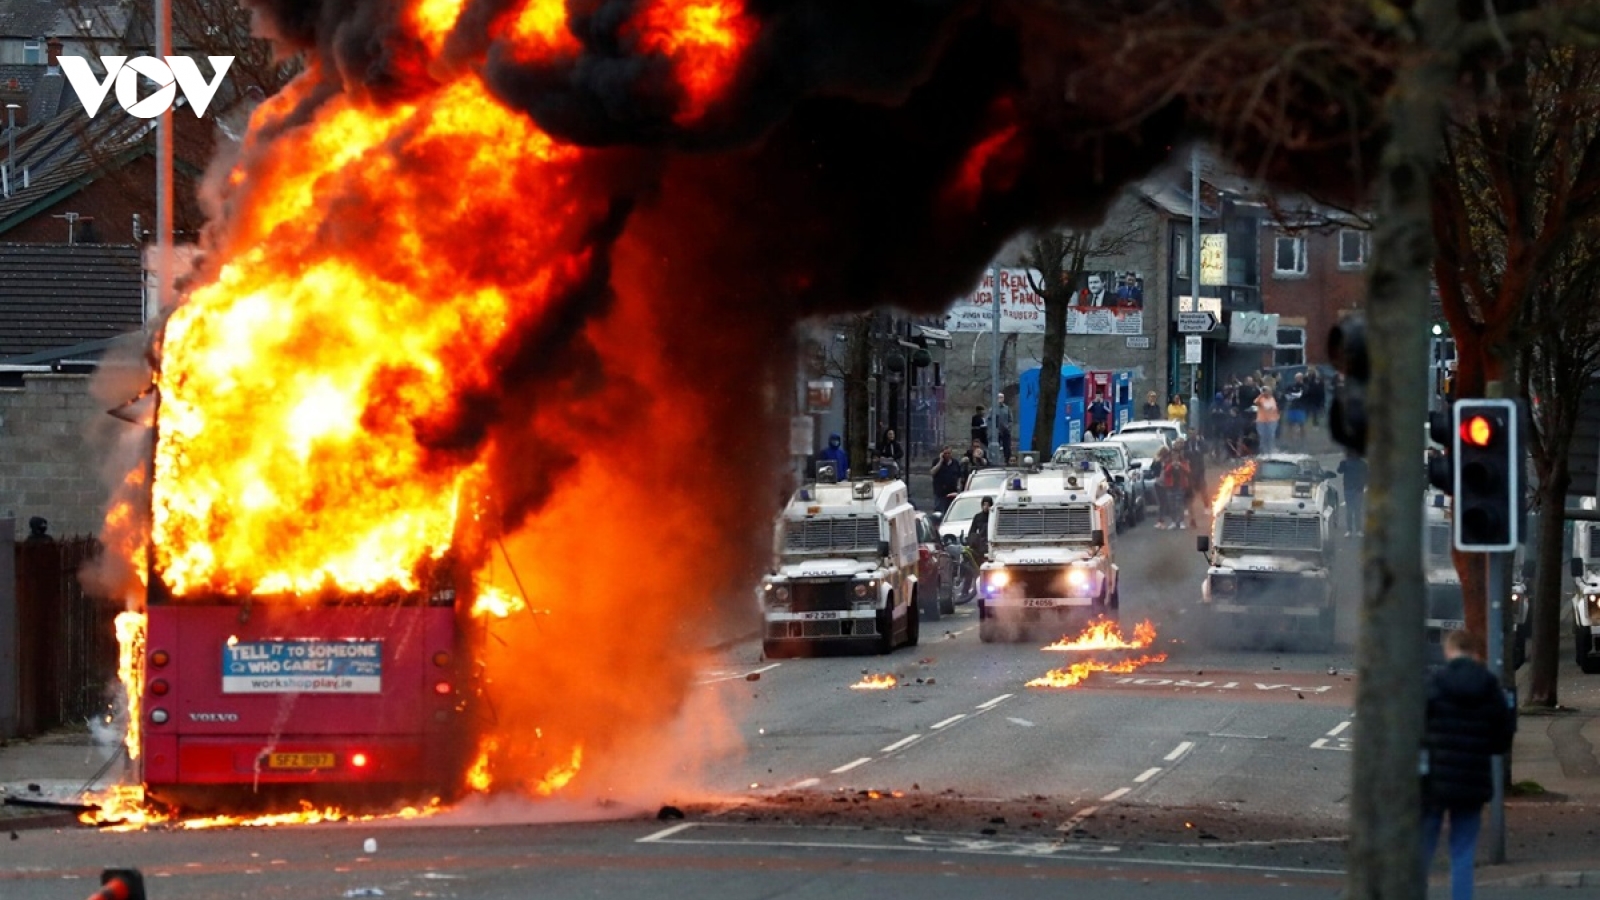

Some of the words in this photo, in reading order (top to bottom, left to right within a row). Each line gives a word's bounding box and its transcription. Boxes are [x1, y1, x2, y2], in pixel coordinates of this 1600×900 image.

[229, 644, 269, 660] TELL
[272, 644, 284, 655] IT
[288, 646, 304, 657] TO
[307, 644, 376, 657] SOMEONE
[248, 661, 281, 673] WHO
[252, 679, 353, 690] workshopplay.ie
[189, 713, 239, 722] VOLVO
[275, 754, 299, 766] SFZ
